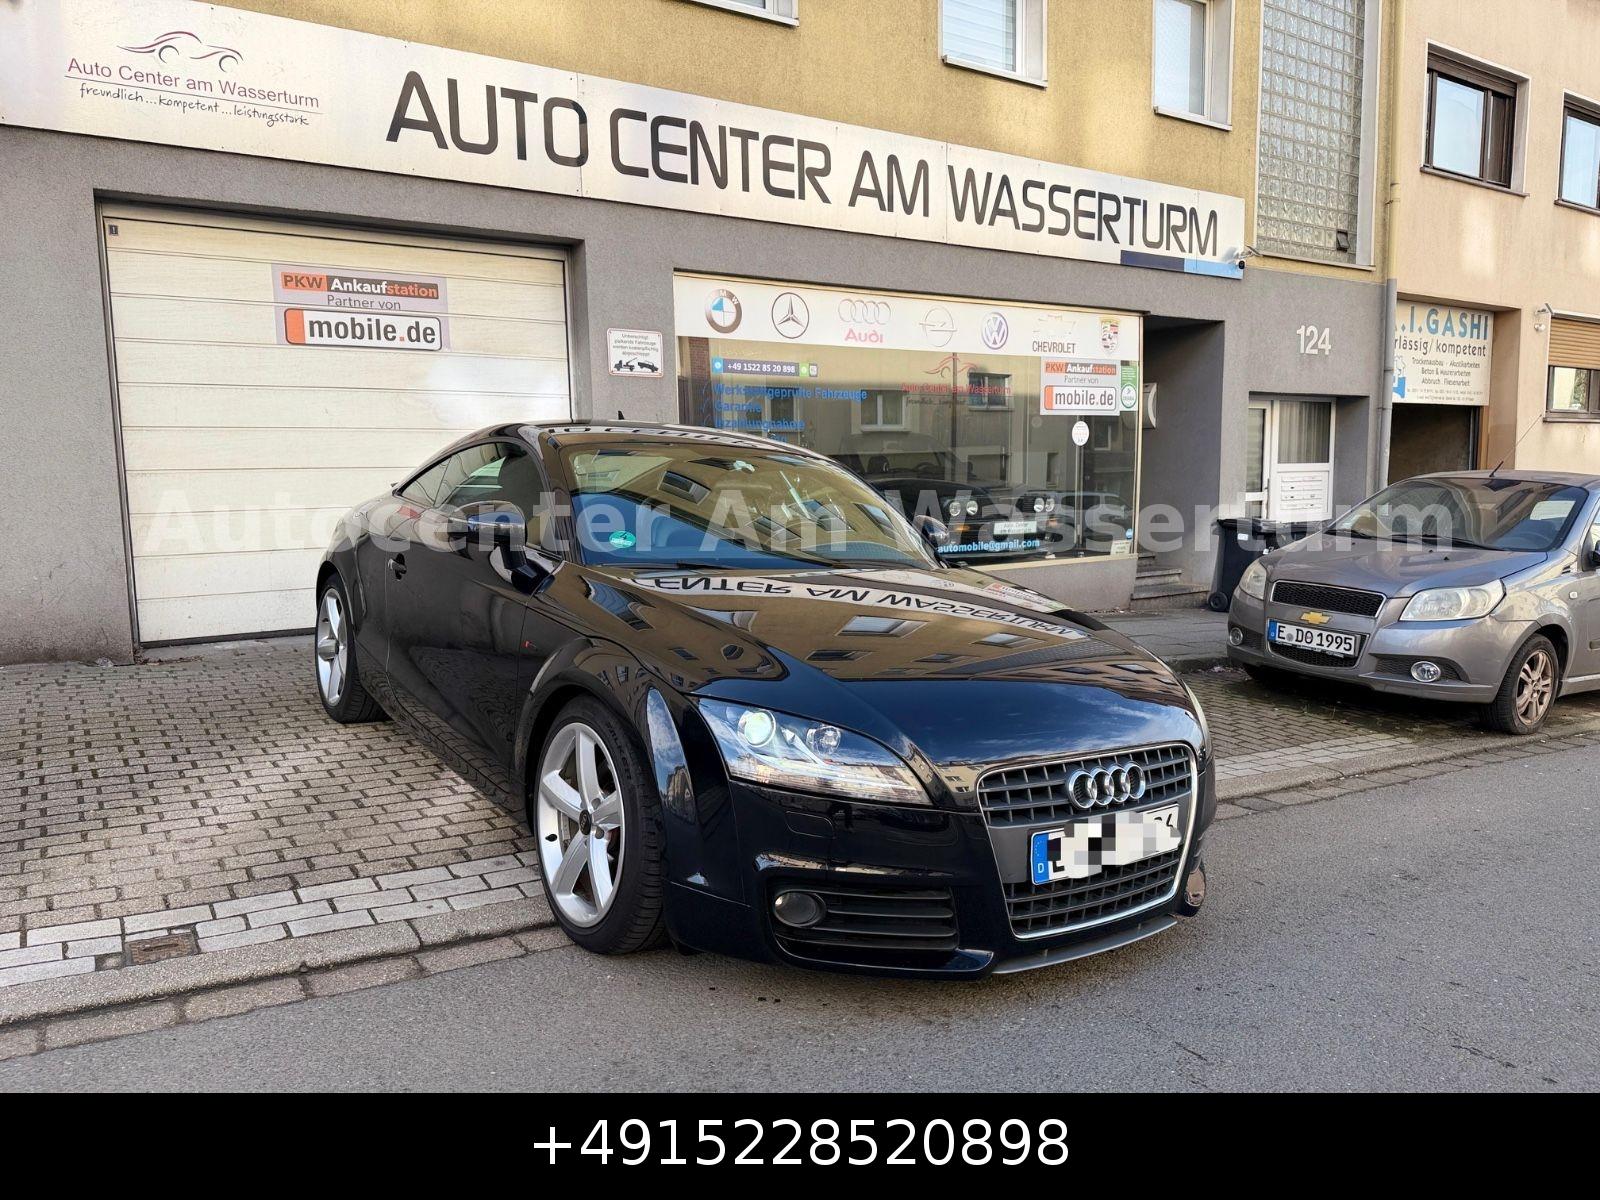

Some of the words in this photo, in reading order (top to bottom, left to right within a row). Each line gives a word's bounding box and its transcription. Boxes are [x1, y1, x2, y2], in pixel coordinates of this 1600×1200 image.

[67, 58, 112, 77] Auto
[118, 65, 181, 87] Center
[186, 77, 214, 93] am
[219, 80, 320, 109] Wasserturm
[385, 70, 589, 168] AUTO
[609, 107, 833, 206] CENTER
[847, 150, 930, 218] AM
[947, 164, 1218, 257] WASSERTURM
[283, 274, 323, 289] PKW
[330, 277, 439, 298] Ankaufstation
[327, 294, 374, 309] Partner
[379, 300, 401, 311] von
[308, 317, 436, 344] mobile.de
[844, 328, 884, 344] Audi
[1032, 340, 1077, 354] CHEVROLET
[1297, 325, 1332, 355] 124
[1436, 340, 1486, 357] kompetent
[727, 362, 742, 371] +49
[743, 363, 760, 371] 1522
[762, 364, 771, 372] 85
[782, 365, 796, 373] 898
[1045, 363, 1064, 373] PKW
[1064, 374, 1086, 384] Partner
[815, 386, 868, 402] Fahrzeuge
[1055, 390, 1114, 406] mobile.de
[1277, 625, 1286, 641] E
[1315, 632, 1353, 652] 1995
[1037, 862, 1045, 874] D
